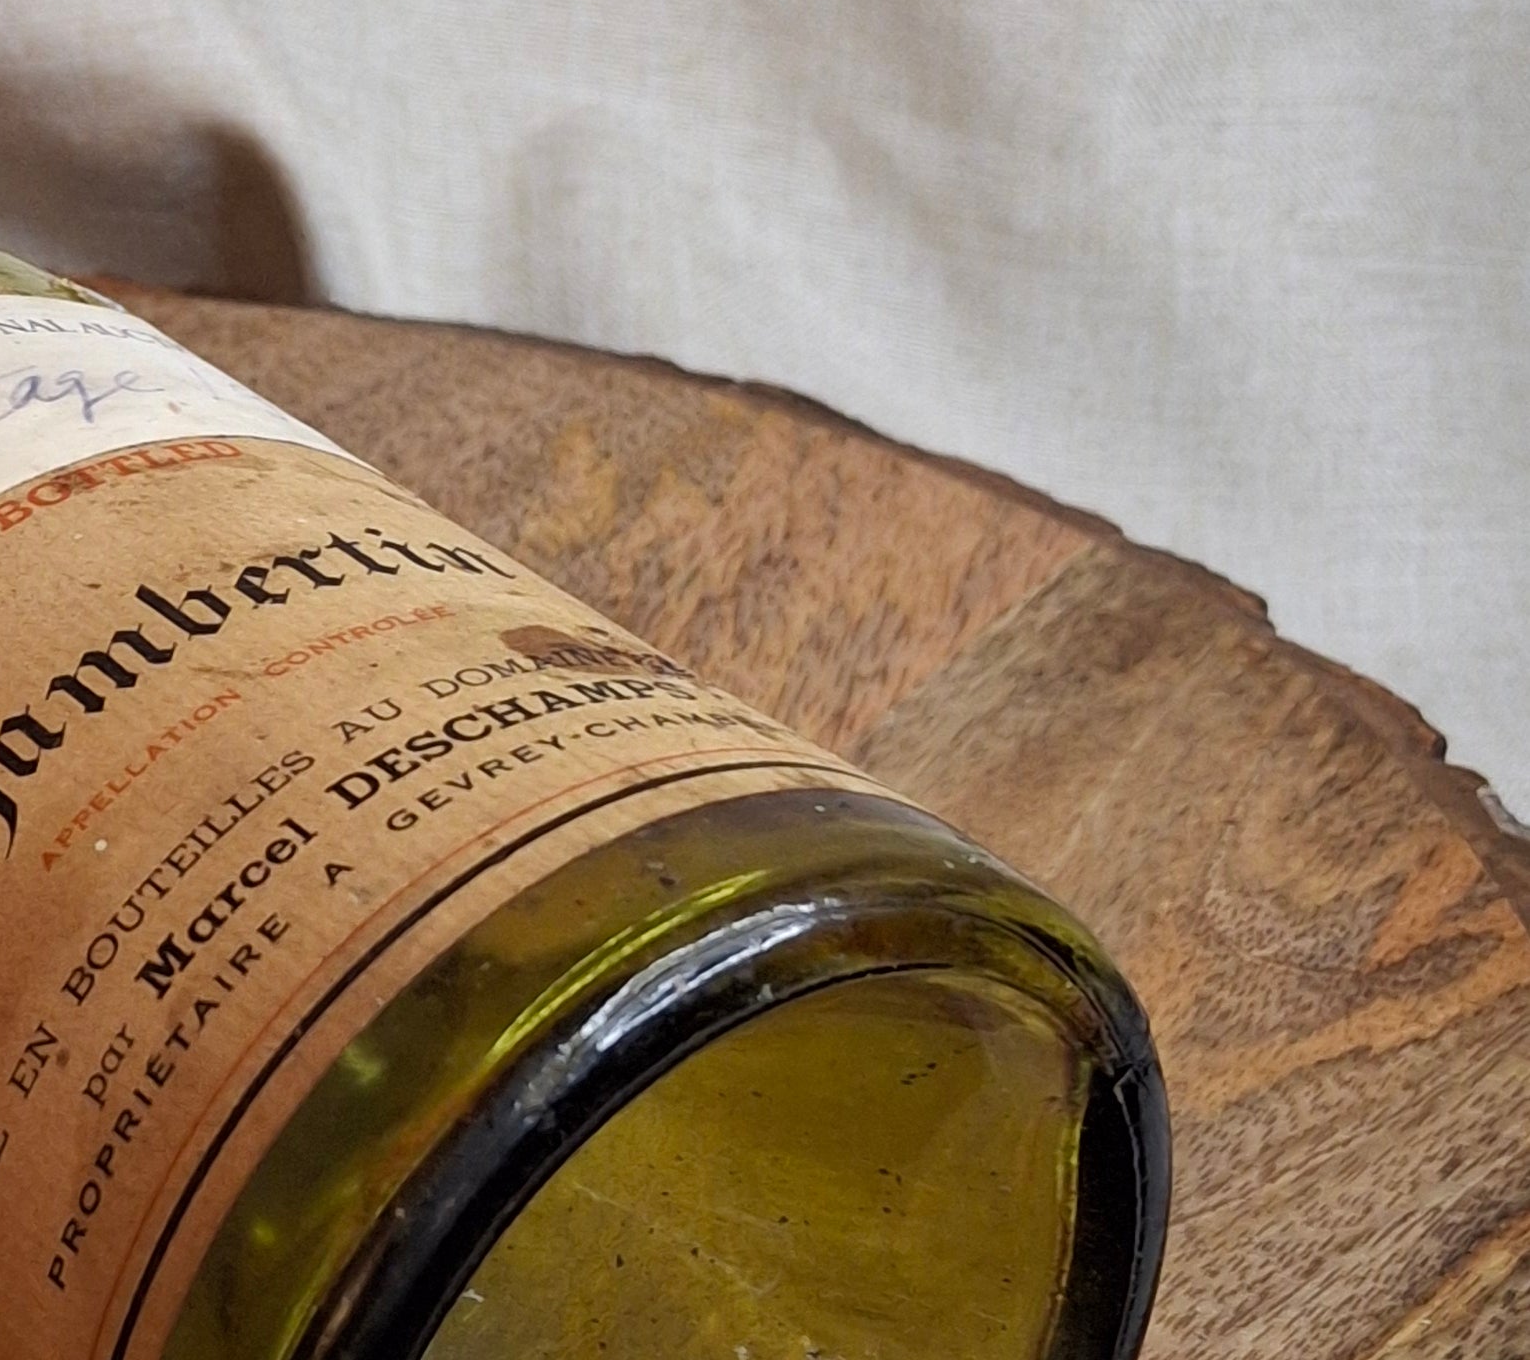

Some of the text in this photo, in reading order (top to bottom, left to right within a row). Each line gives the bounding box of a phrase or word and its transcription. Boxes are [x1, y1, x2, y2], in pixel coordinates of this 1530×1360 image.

[8, 1022, 61, 1099] EN
[61, 750, 316, 1006] BOUTEILLES
[332, 698, 404, 744] AU
[41, 688, 243, 872] APPELLATION
[82, 677, 698, 1109] par Marcel DESCHAMPS
[47, 912, 293, 1291] PROPRIÉTAIRE
[322, 860, 356, 887] A
